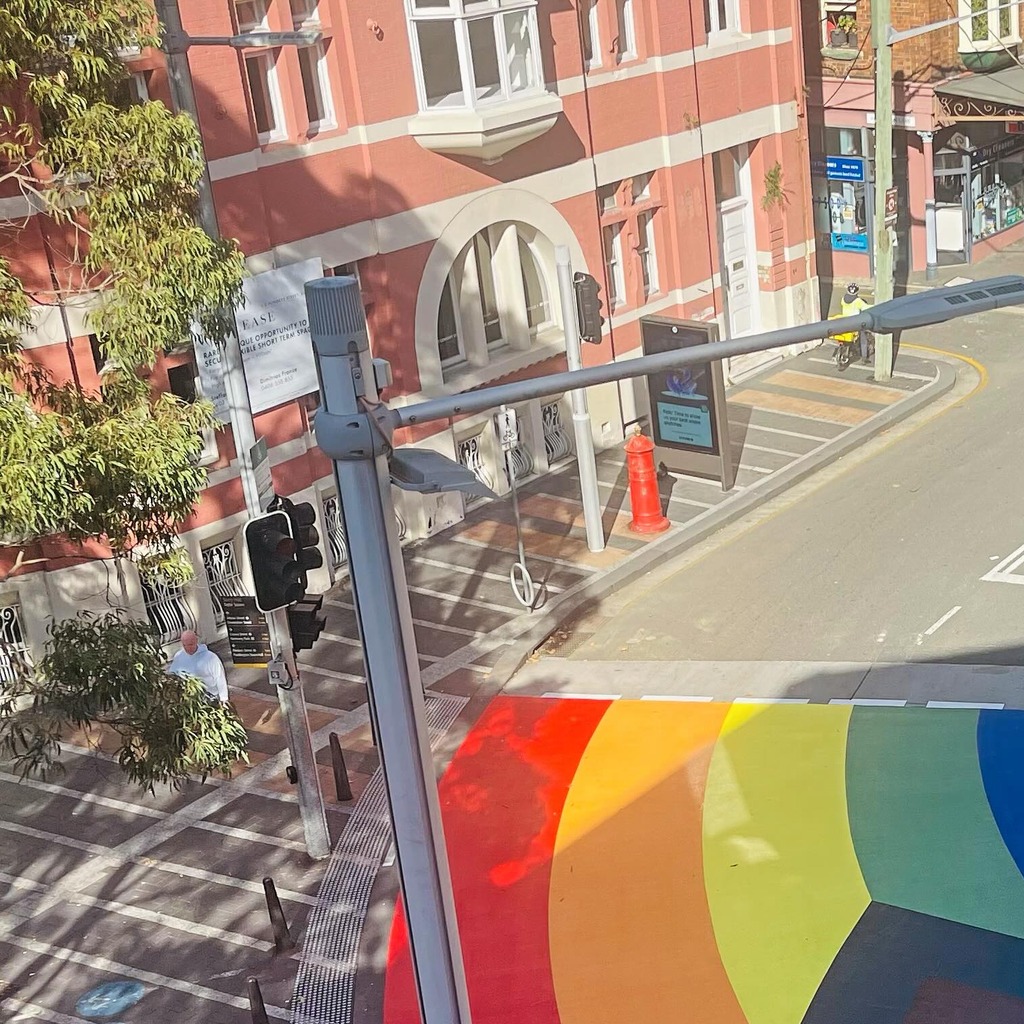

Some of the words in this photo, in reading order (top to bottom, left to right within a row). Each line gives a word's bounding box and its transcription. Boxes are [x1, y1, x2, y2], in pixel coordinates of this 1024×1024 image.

[240, 336, 255, 347] QUE
[255, 323, 297, 342] OPPORTUNITY
[298, 319, 307, 327] TO
[242, 312, 276, 331] EASE
[204, 357, 222, 368] SECU
[241, 345, 256, 355] XIBLE
[258, 337, 278, 349] SHORT
[279, 332, 296, 341] TERM
[296, 327, 311, 337] SPAC
